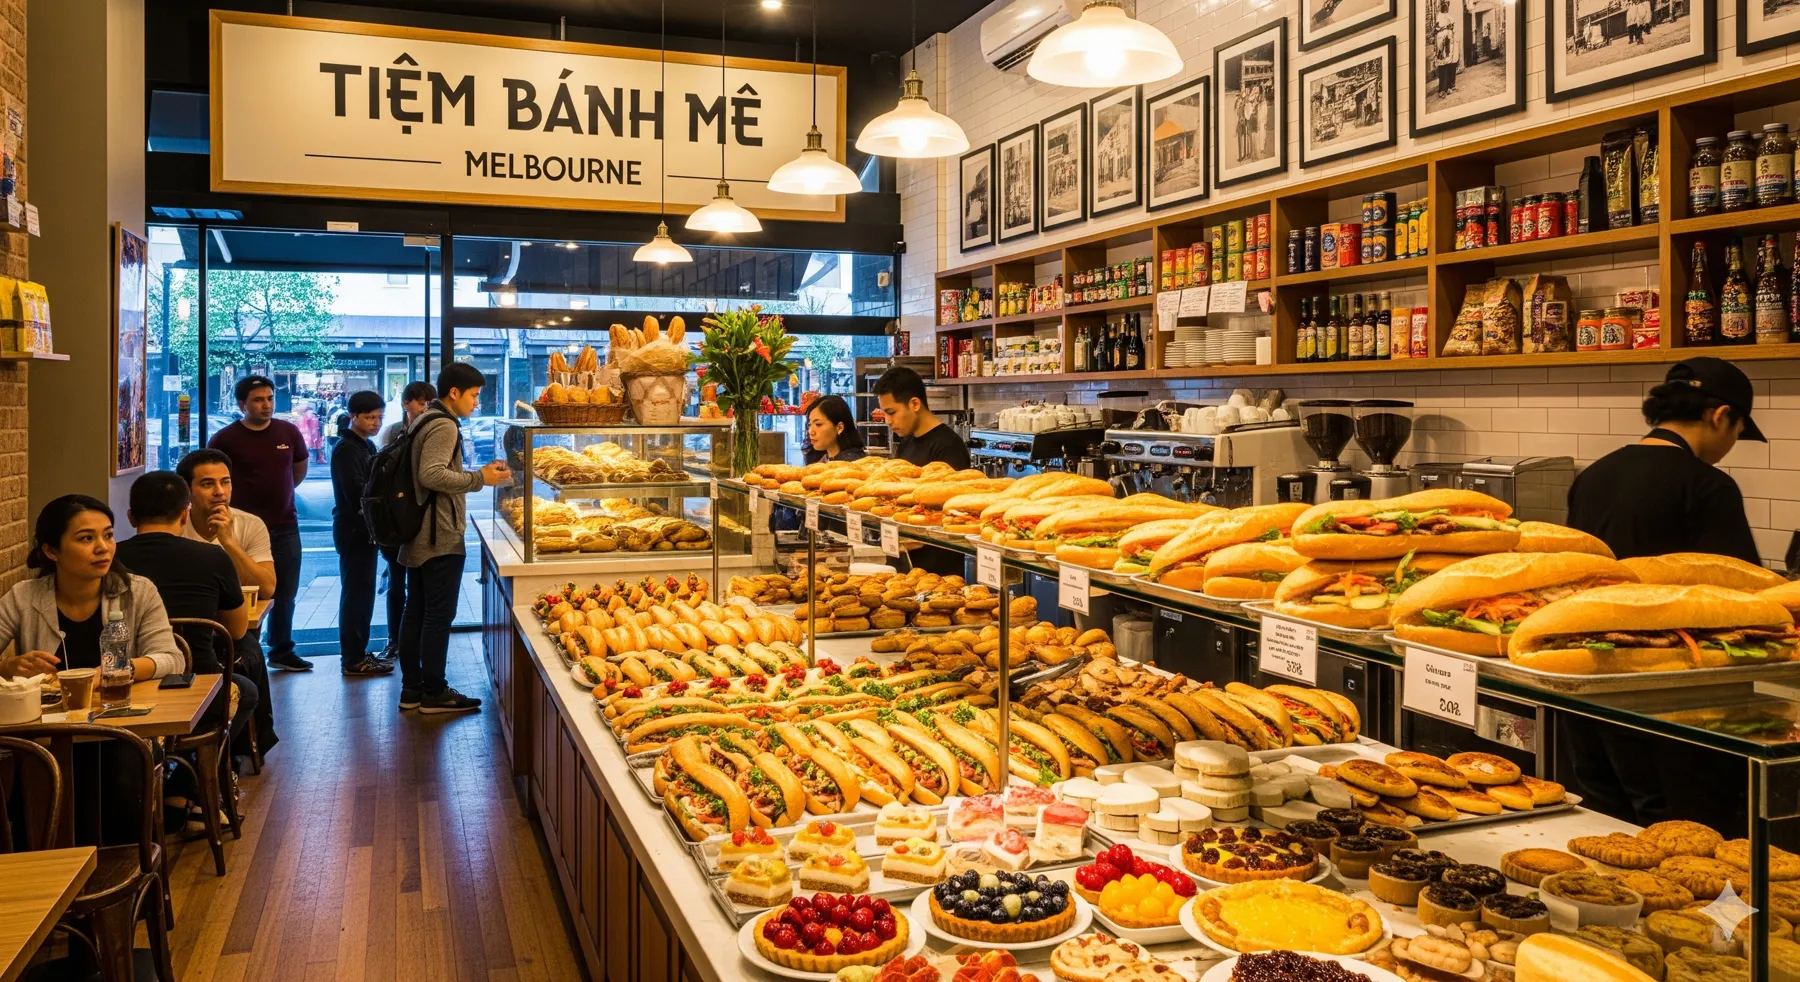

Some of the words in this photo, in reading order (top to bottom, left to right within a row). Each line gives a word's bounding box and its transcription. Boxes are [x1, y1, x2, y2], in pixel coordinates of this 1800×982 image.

[319, 52, 475, 135] TIỆM
[502, 68, 664, 140] BÁNH
[685, 83, 764, 147] MÊ
[464, 150, 642, 186] MELBOURNE
